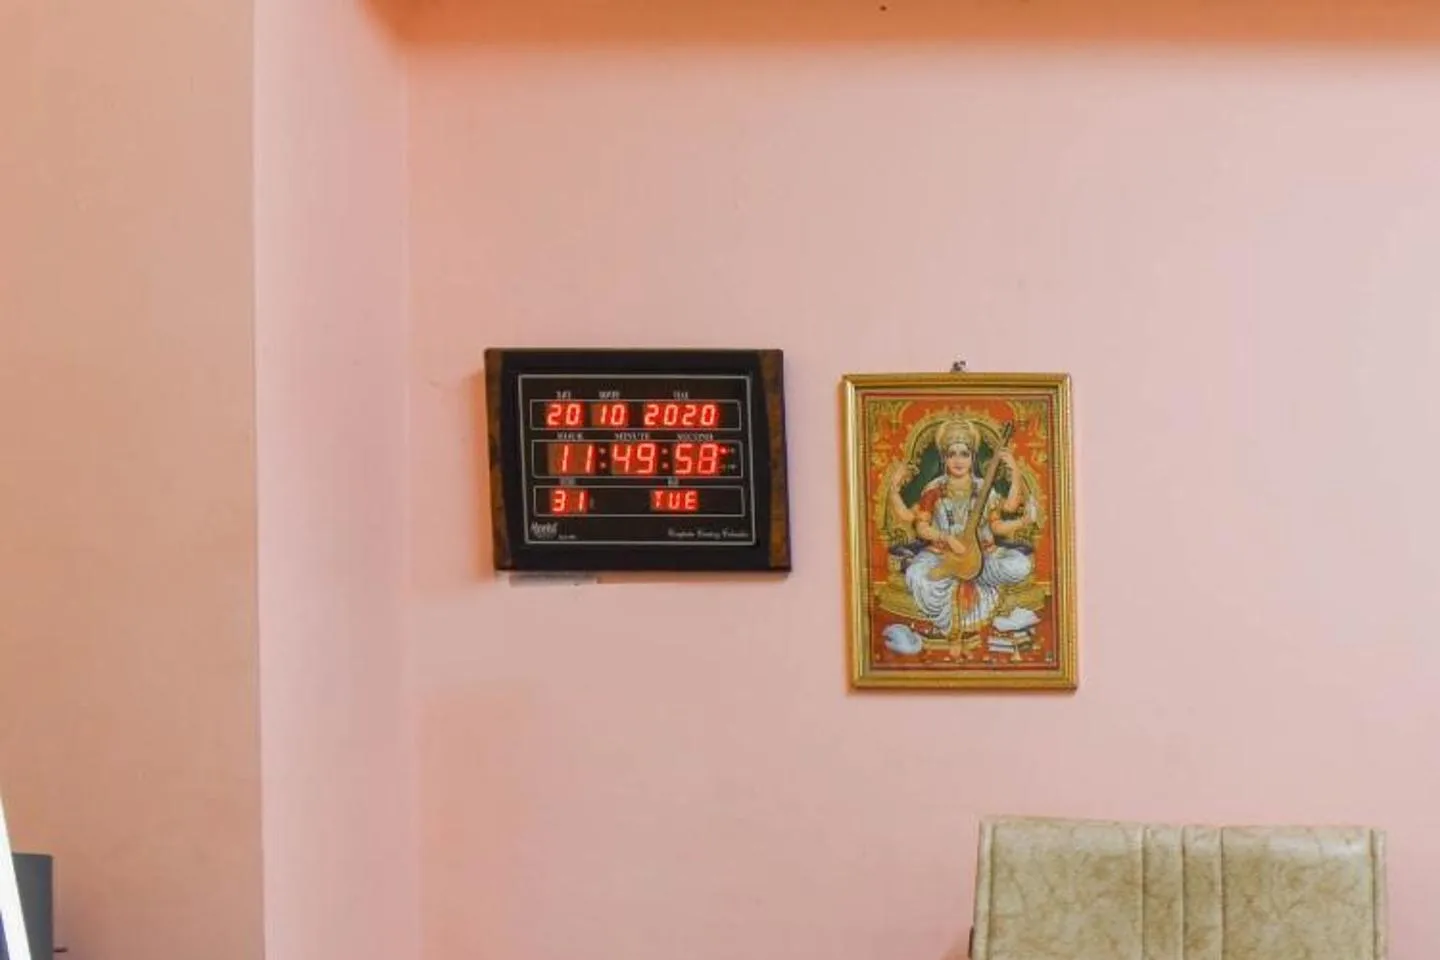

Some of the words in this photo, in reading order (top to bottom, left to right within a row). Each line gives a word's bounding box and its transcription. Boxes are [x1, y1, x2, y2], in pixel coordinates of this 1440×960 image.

[546, 403, 581, 426] 20
[600, 403, 625, 426] 10
[643, 403, 717, 426] 2020
[552, 490, 584, 513] 31
[653, 491, 698, 511] TUE
